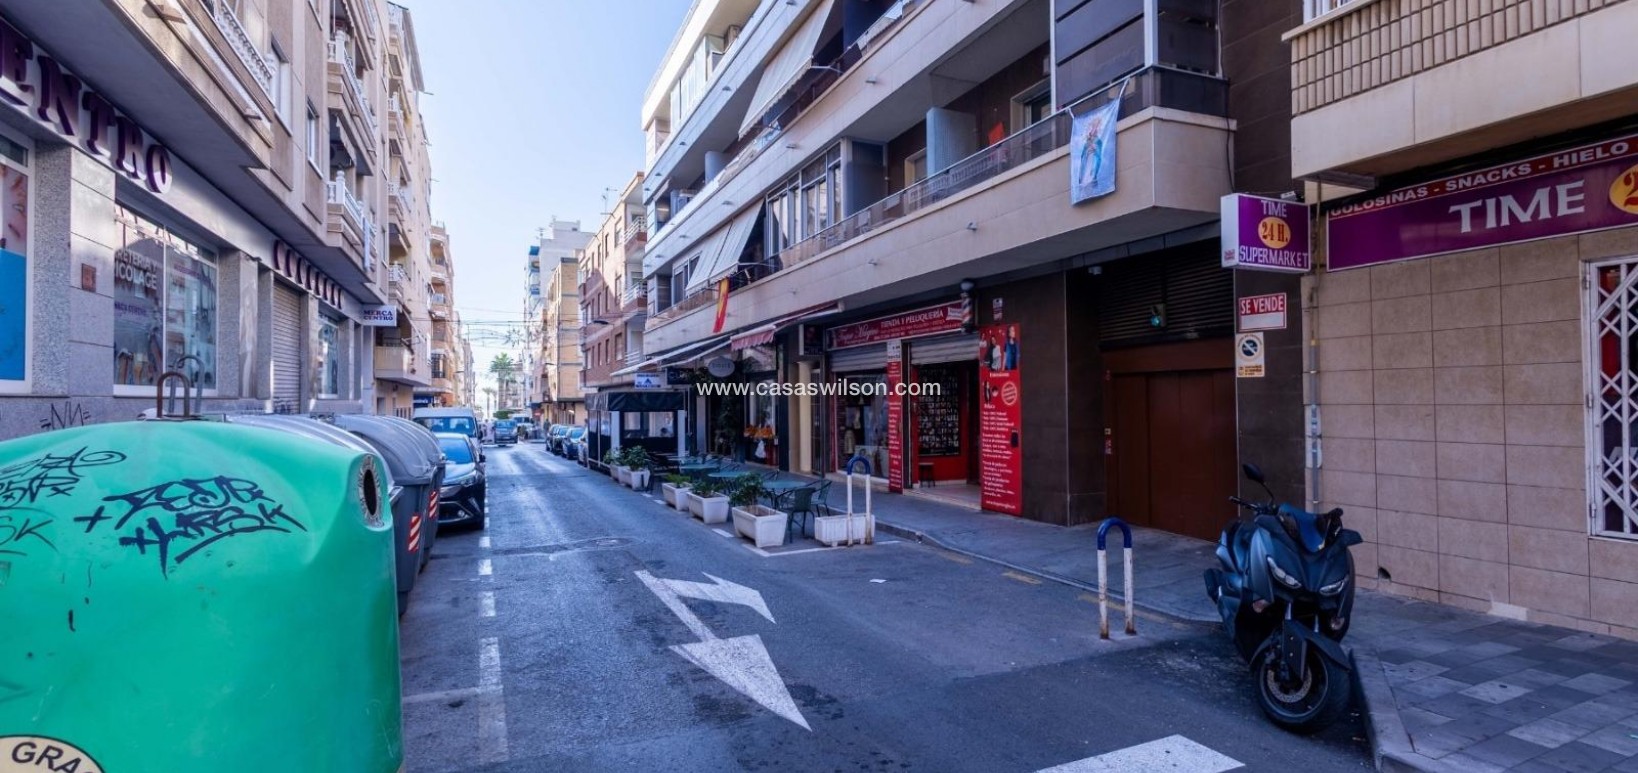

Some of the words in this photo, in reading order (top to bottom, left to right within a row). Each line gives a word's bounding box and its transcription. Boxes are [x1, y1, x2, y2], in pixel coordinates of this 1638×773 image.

[1445, 163, 1532, 191] SNACKS
[1553, 142, 1629, 168] HIELO
[1261, 199, 1287, 217] TIME
[1448, 179, 1586, 234] TIME
[1262, 221, 1275, 241] 24
[1239, 244, 1309, 269] SUPERMARKET
[1241, 299, 1251, 314] SE
[1253, 295, 1284, 313] VENDE
[12, 741, 96, 773] GRA
